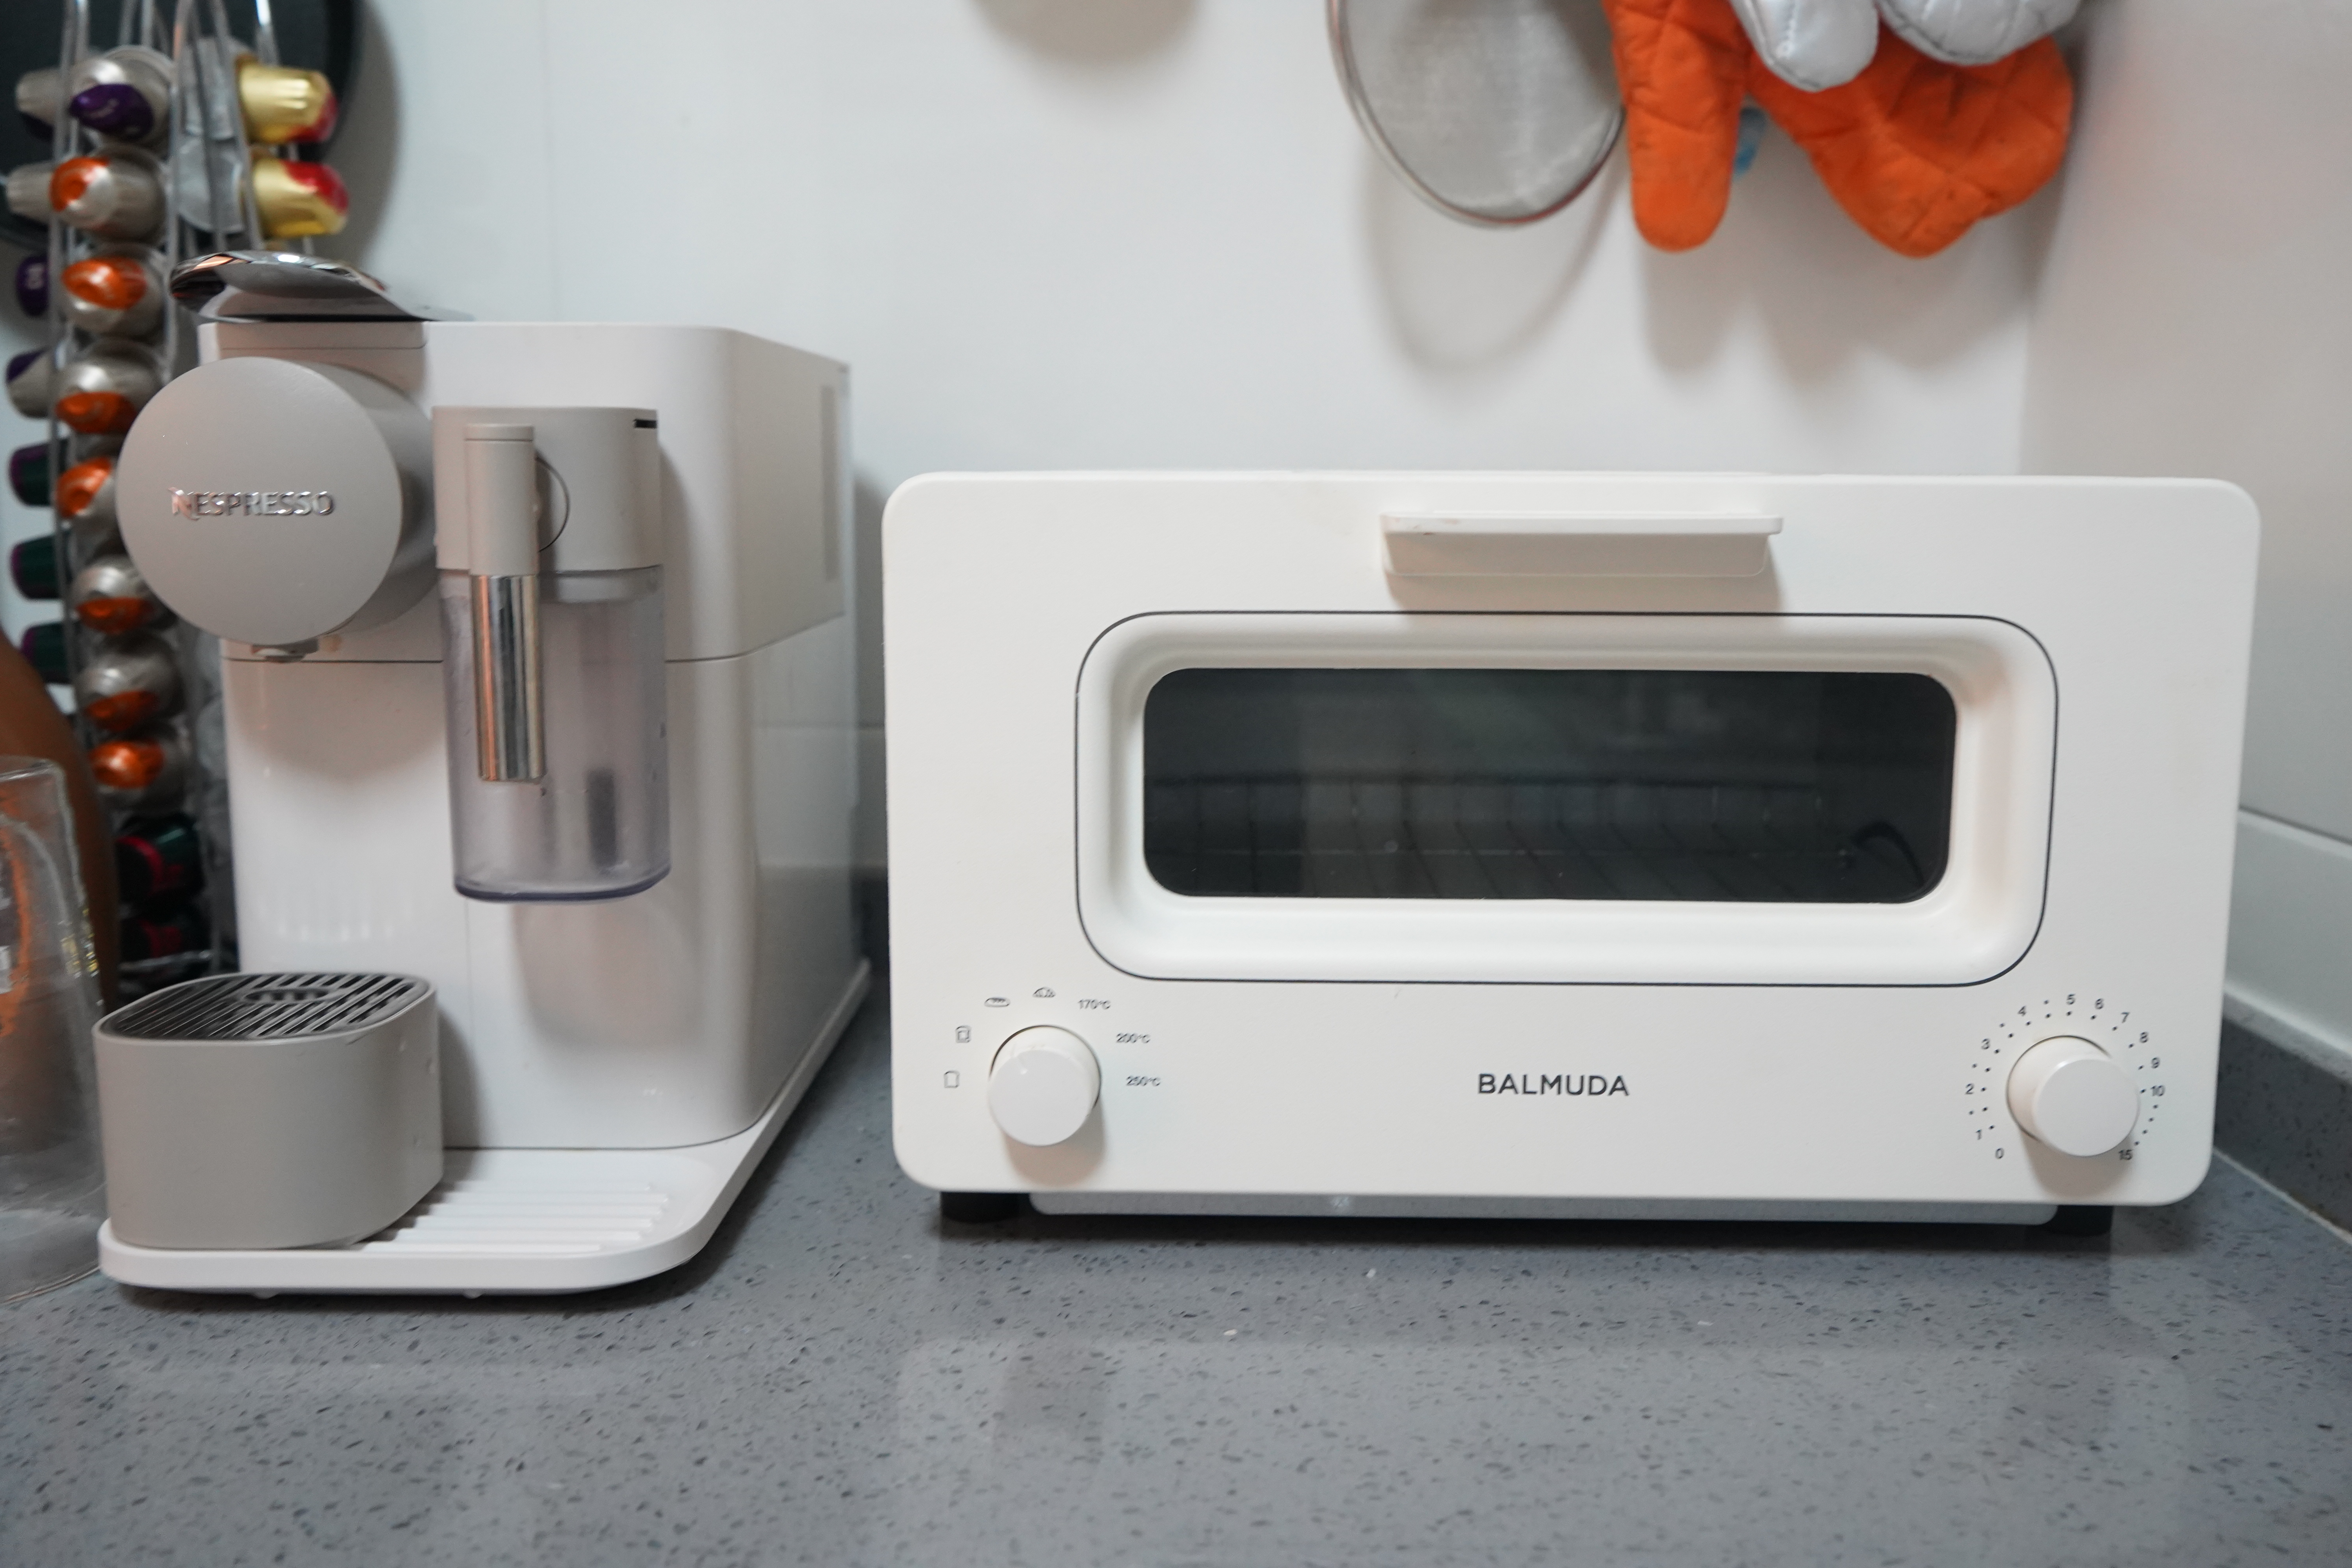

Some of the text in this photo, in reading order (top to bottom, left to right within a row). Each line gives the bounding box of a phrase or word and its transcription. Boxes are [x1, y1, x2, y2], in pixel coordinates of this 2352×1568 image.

[167, 487, 336, 521] NESPRESSO
[1078, 999, 1111, 1010] 170°C
[2067, 994, 2075, 1005] 5
[2018, 1006, 2026, 1016] 4
[2121, 1012, 2130, 1023] 7
[1116, 1033, 1151, 1044] 200°C
[1982, 1038, 1990, 1050] 3
[2140, 1032, 2148, 1044] 8
[2151, 1057, 2160, 1069] 9
[1478, 1073, 1630, 1096] BALMUDA
[1965, 1083, 1974, 1095] 2
[2151, 1085, 2165, 1097] 10
[1975, 1129, 1982, 1140] 1
[1995, 1147, 2004, 1159] 0
[2118, 1149, 2132, 1161] 15
